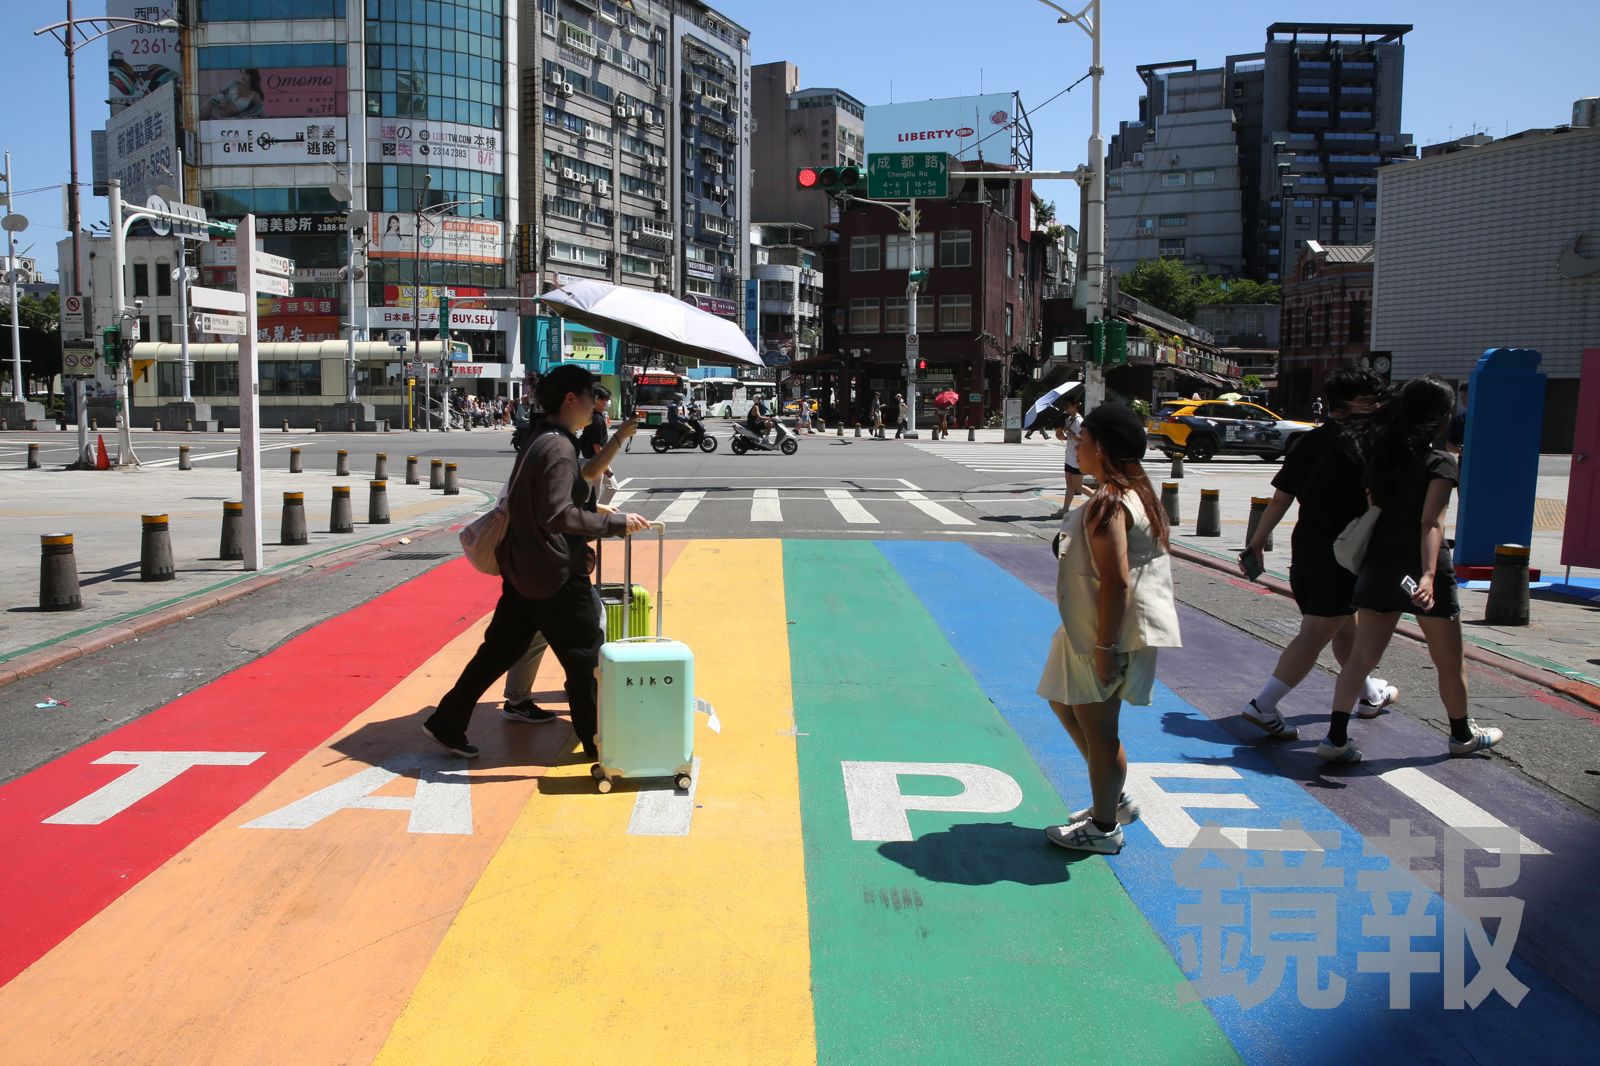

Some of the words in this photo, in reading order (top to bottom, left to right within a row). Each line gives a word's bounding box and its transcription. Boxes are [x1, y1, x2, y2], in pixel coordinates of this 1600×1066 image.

[898, 129, 954, 142] LIBERTY
[307, 141, 336, 155] 逃脫
[877, 155, 938, 169] 成都路
[888, 171, 916, 179] ChengDu
[256, 217, 312, 233] 醫美診所
[142, 366, 148, 383] 1
